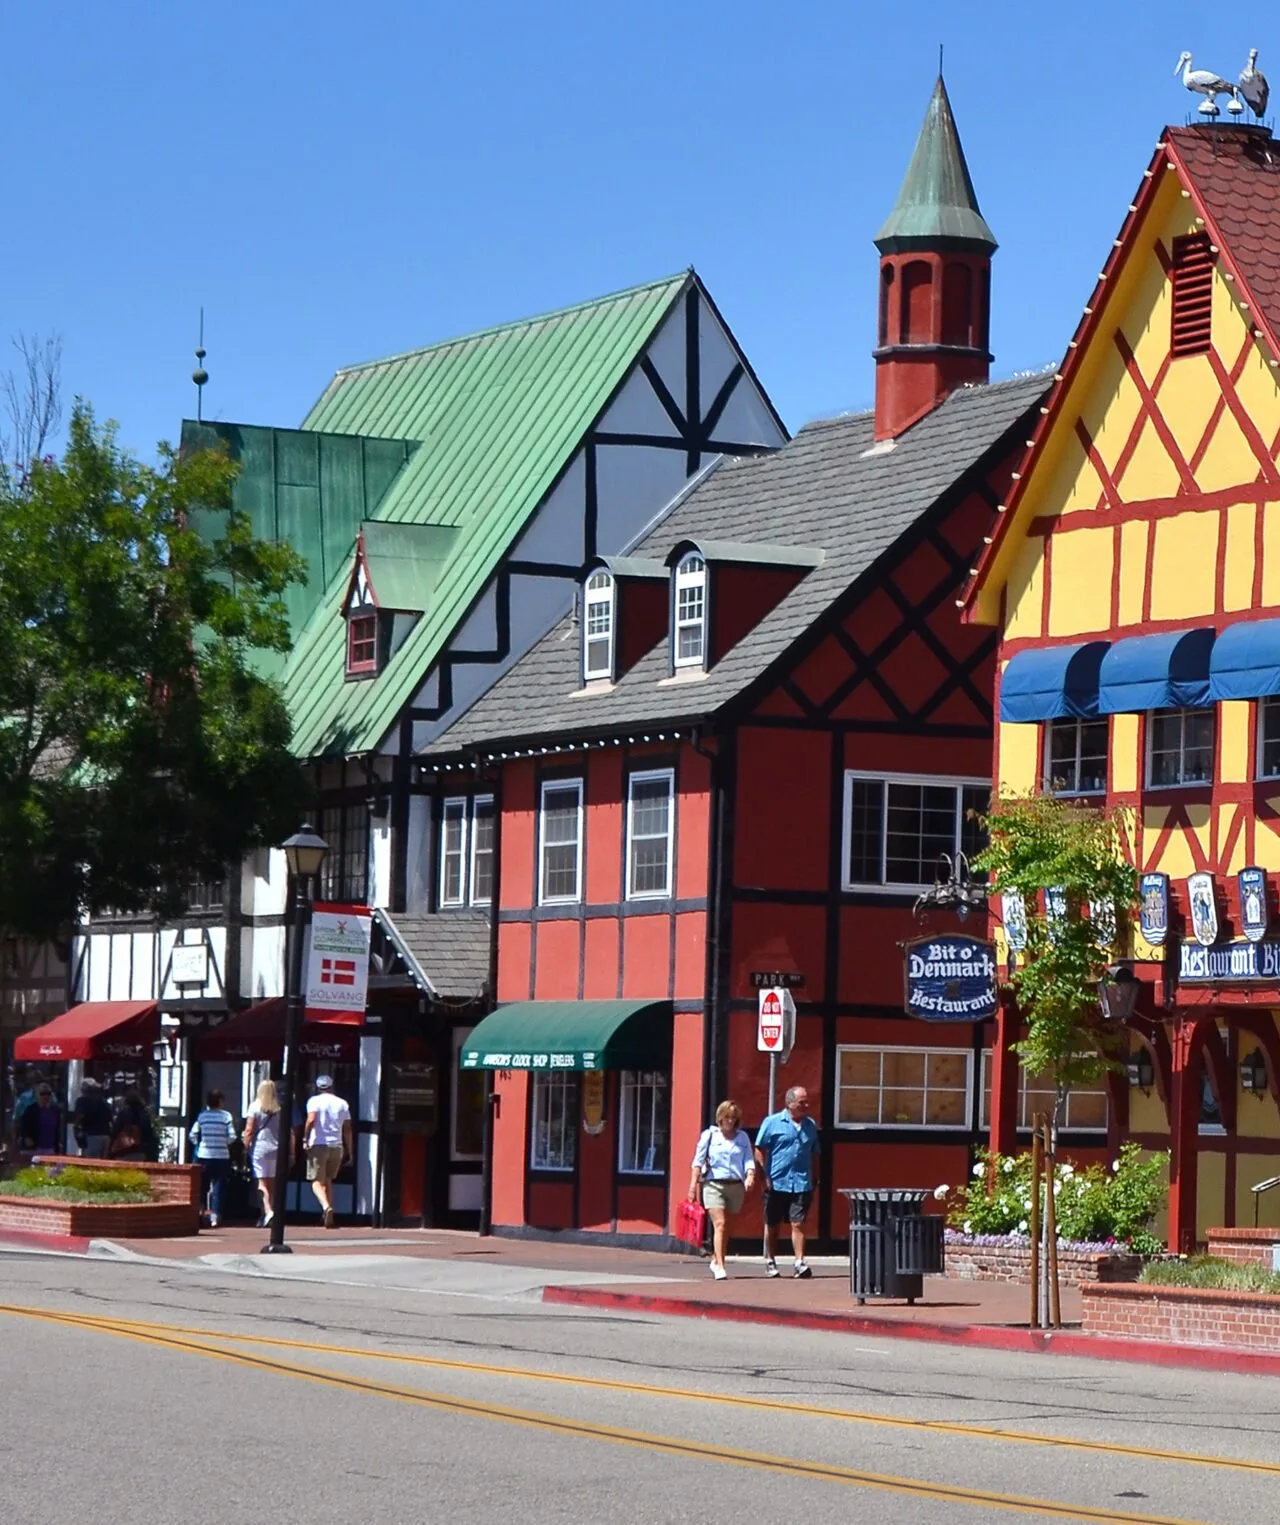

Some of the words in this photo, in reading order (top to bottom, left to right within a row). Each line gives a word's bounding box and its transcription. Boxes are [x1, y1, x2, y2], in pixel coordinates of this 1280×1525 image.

[927, 944, 957, 960] Bit
[1180, 944, 1256, 976] Restaurant
[908, 953, 996, 980] Denmark
[754, 974, 786, 985] PARK
[309, 988, 364, 1001] SOLVANG
[908, 988, 996, 1013] Restaurant
